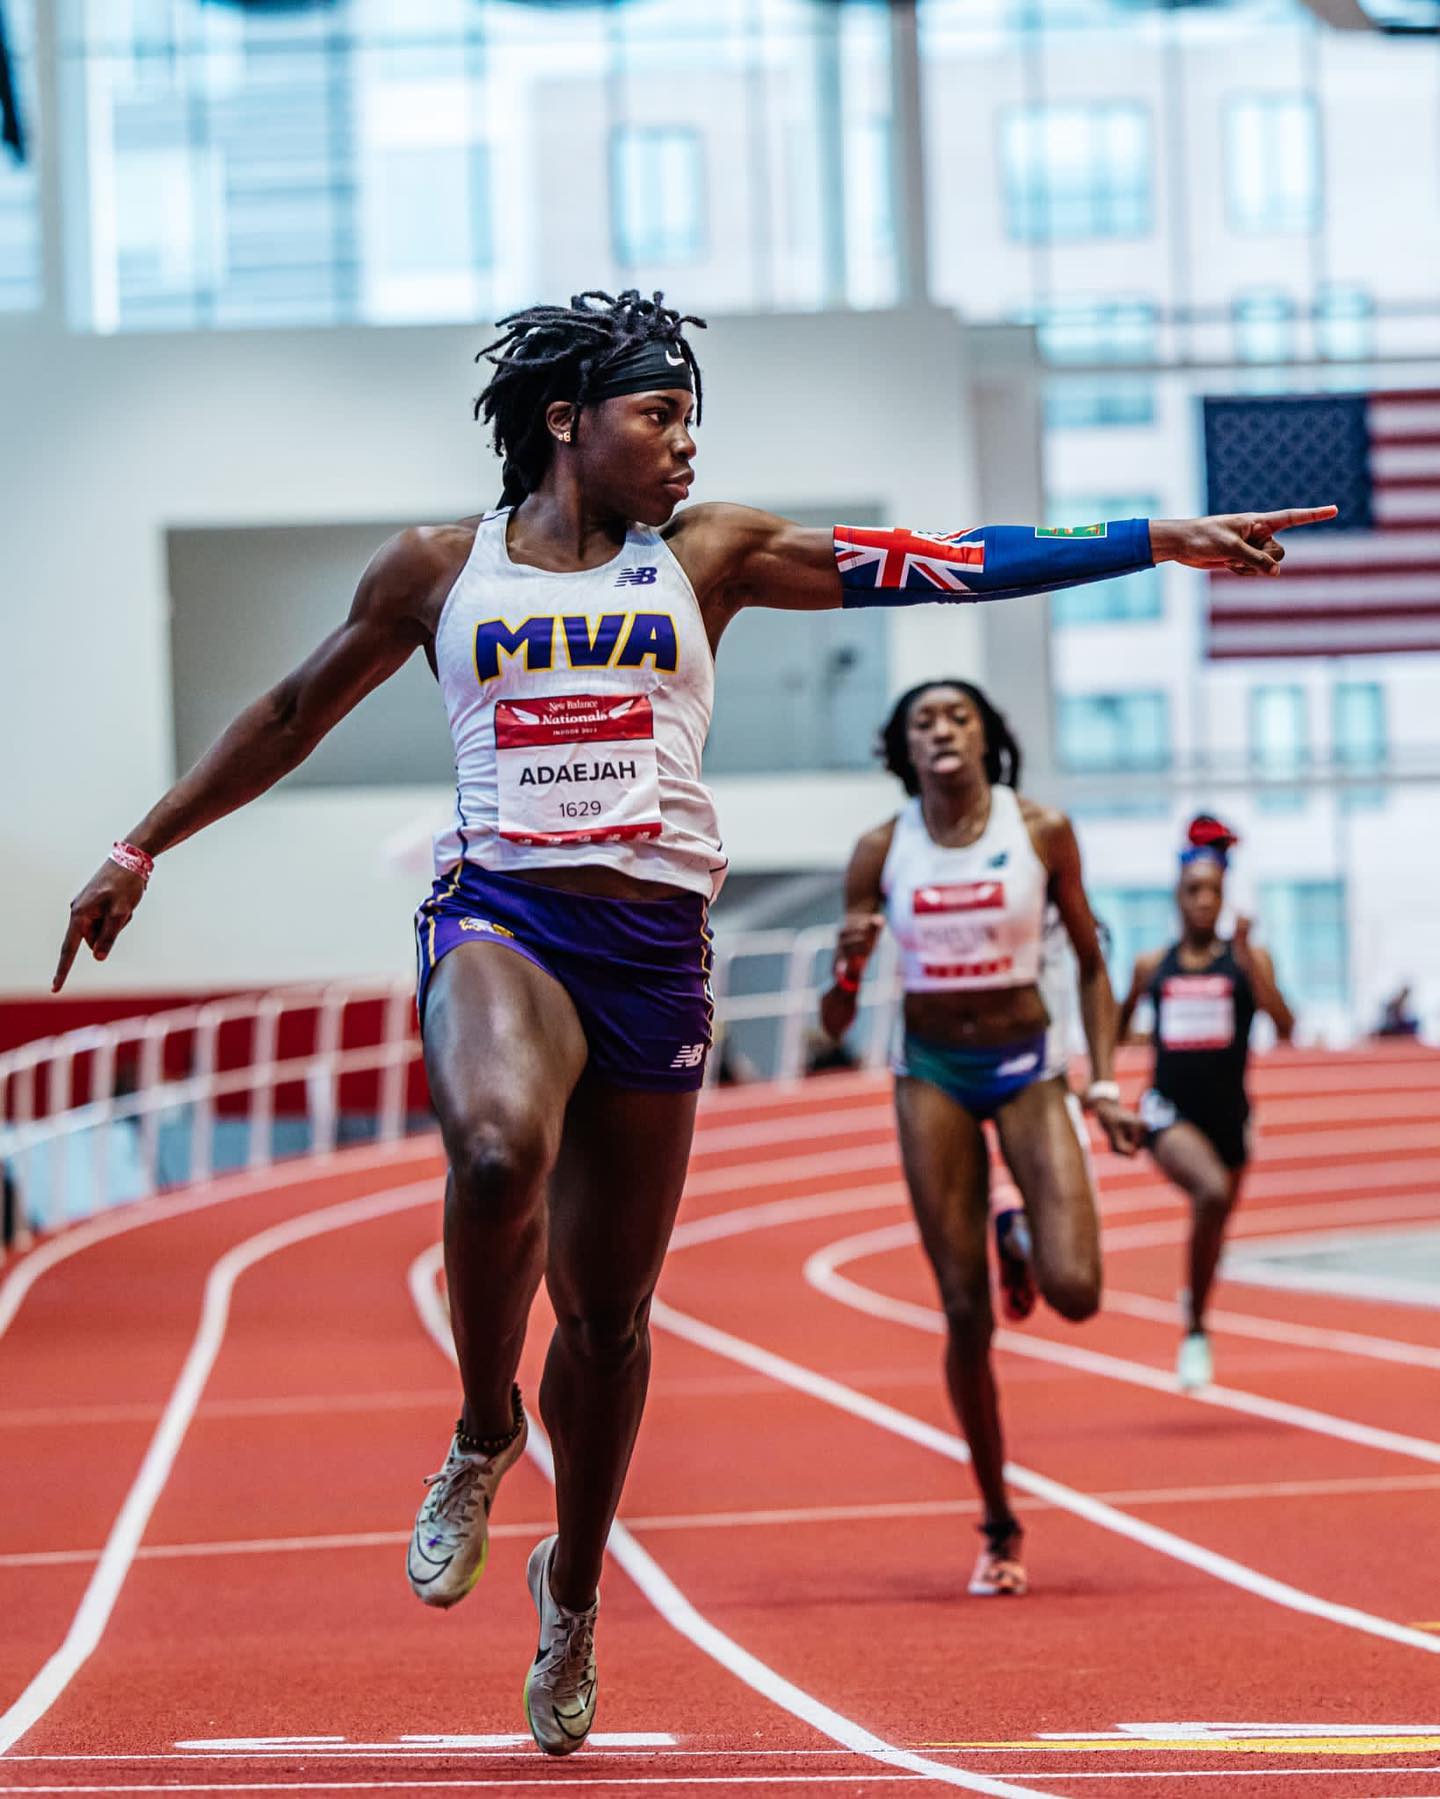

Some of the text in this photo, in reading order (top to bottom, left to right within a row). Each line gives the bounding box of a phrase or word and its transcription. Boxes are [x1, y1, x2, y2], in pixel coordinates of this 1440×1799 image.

[614, 566, 658, 587] NB
[474, 612, 678, 685] MVA
[549, 699, 598, 713] New Balance
[541, 709, 608, 725] Nationals
[519, 760, 636, 786] ADAEJAH
[559, 800, 602, 818] 1629
[670, 1043, 705, 1068] NB
